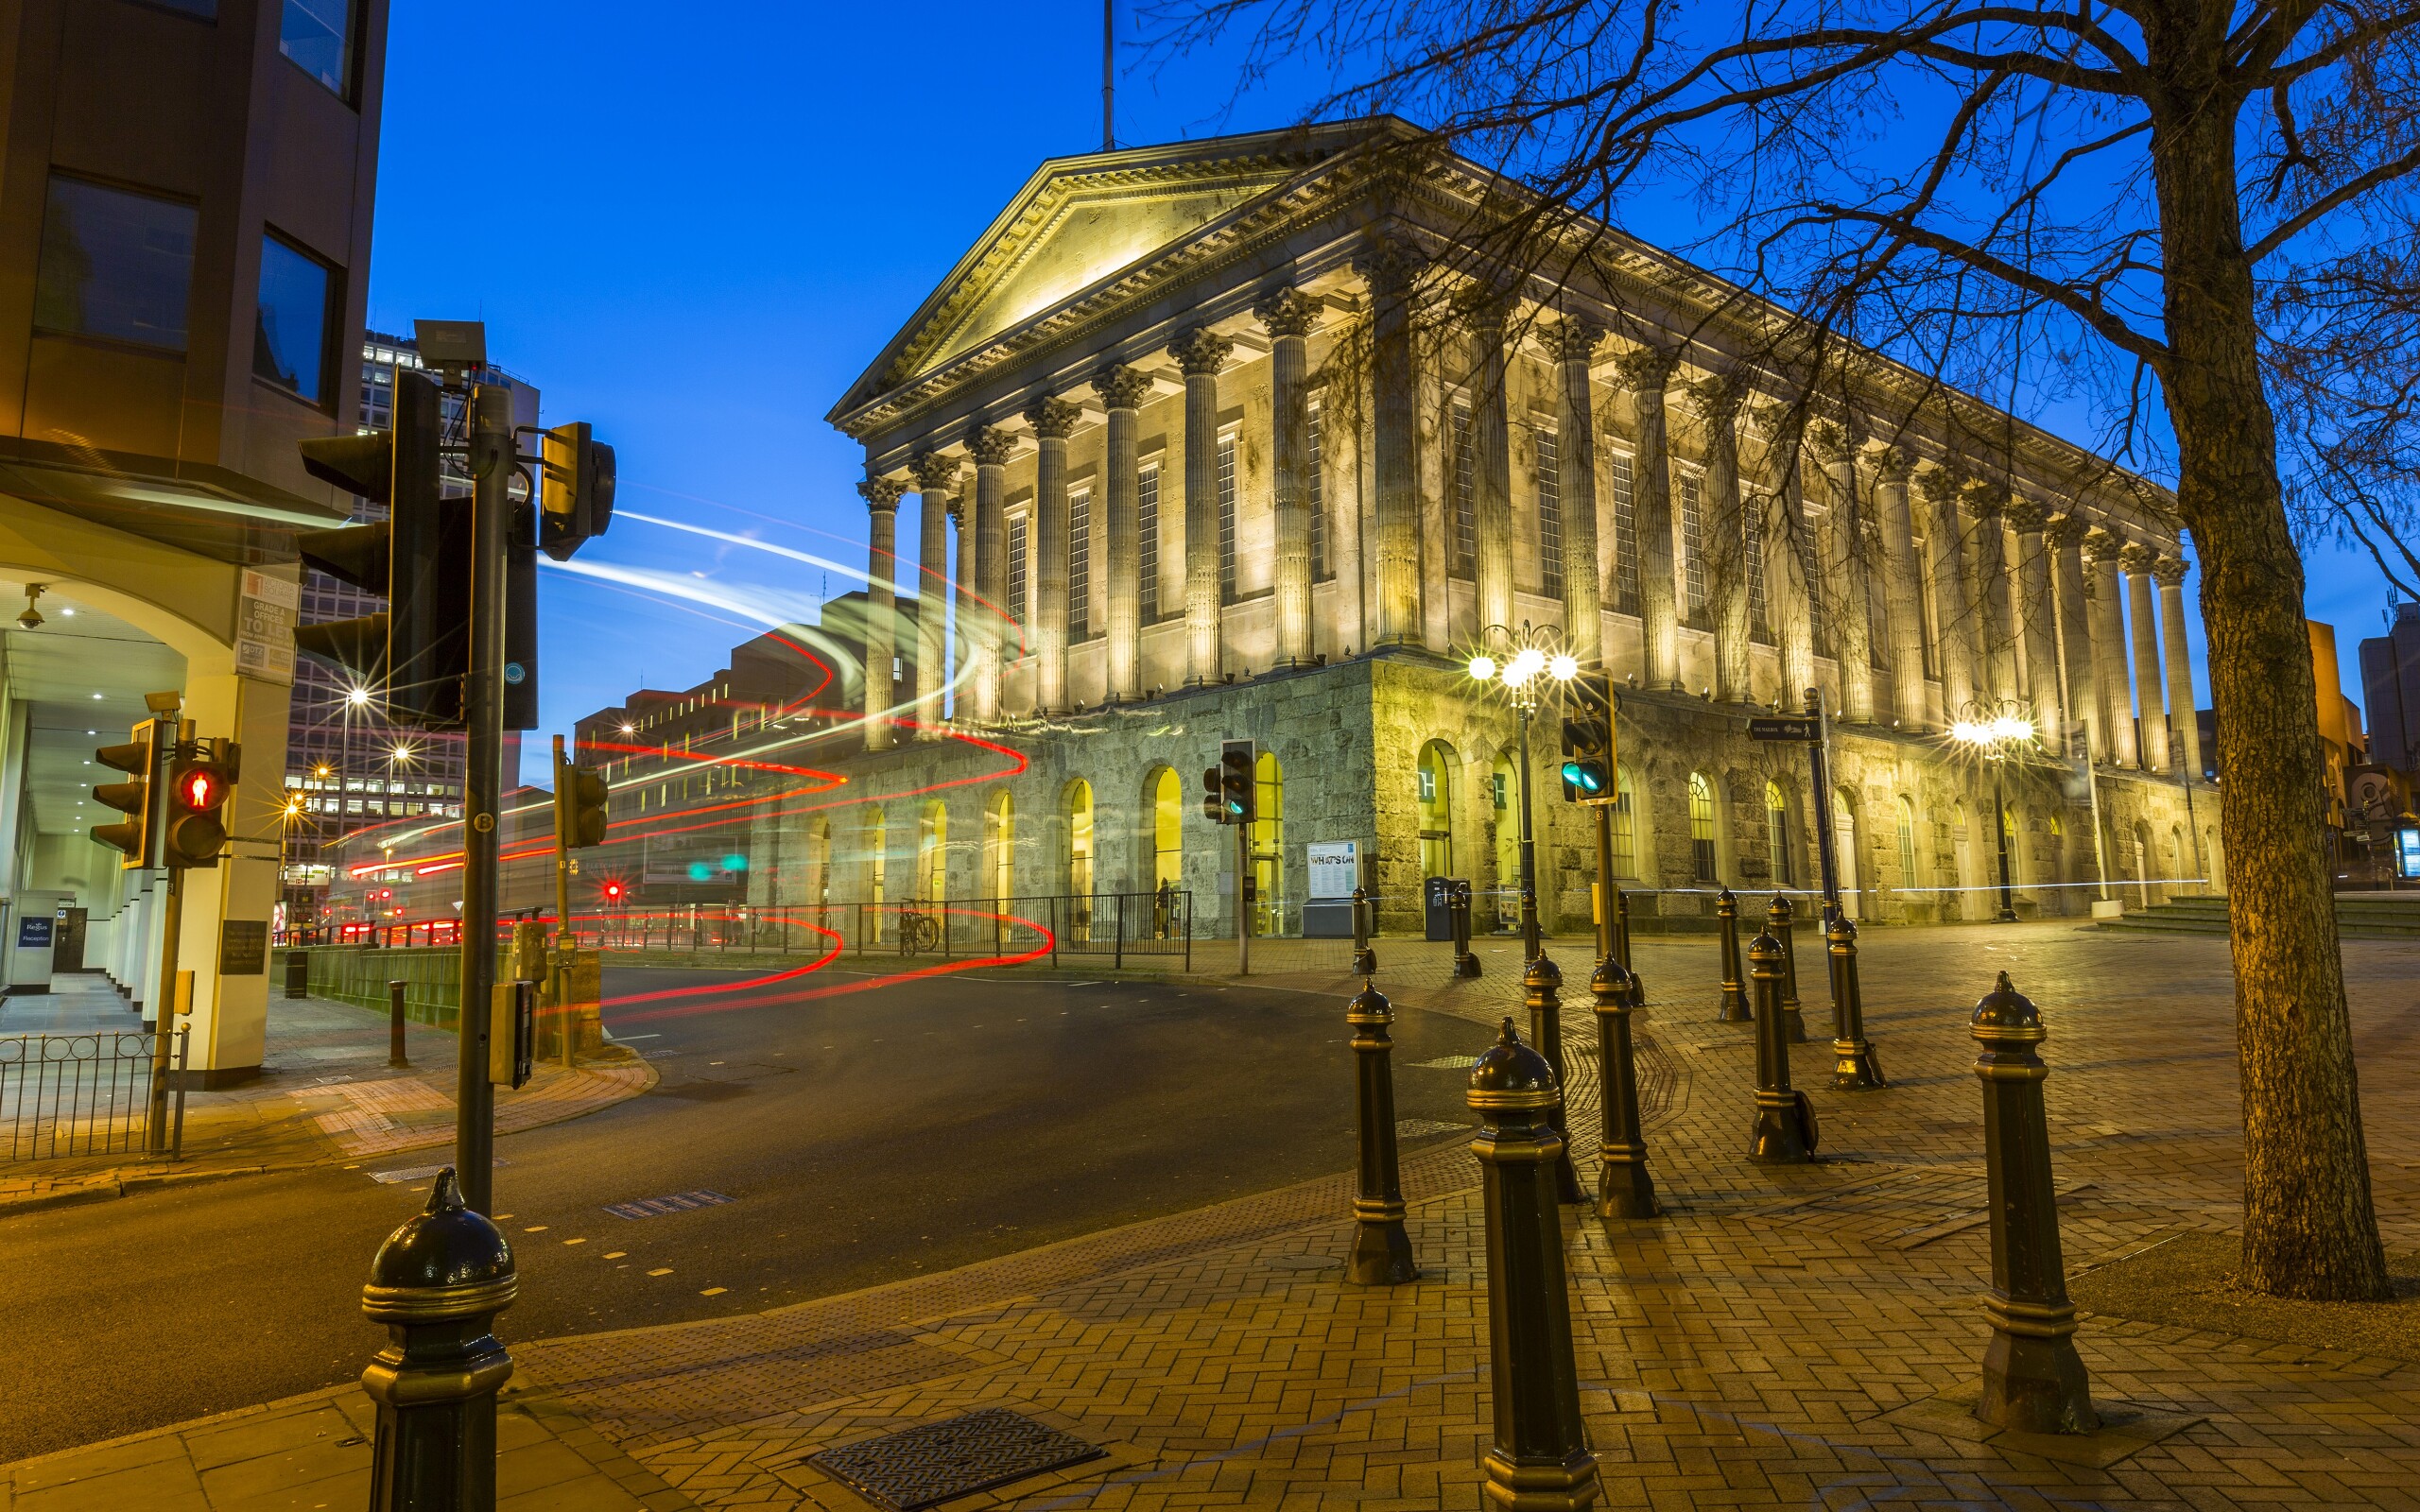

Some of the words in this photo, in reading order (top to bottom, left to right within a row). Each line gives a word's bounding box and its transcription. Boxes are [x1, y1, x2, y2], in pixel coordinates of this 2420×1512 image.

[265, 577, 294, 593] VICTORIA
[264, 586, 294, 600] SQUARE
[253, 601, 279, 614] GRADE
[280, 608, 285, 616] A
[253, 610, 284, 625] OFFICES
[244, 617, 263, 632] TO
[268, 623, 291, 639] LET
[251, 644, 264, 654] DTZ
[1310, 855, 1341, 865] WHAT'S
[1342, 855, 1355, 864] ON
